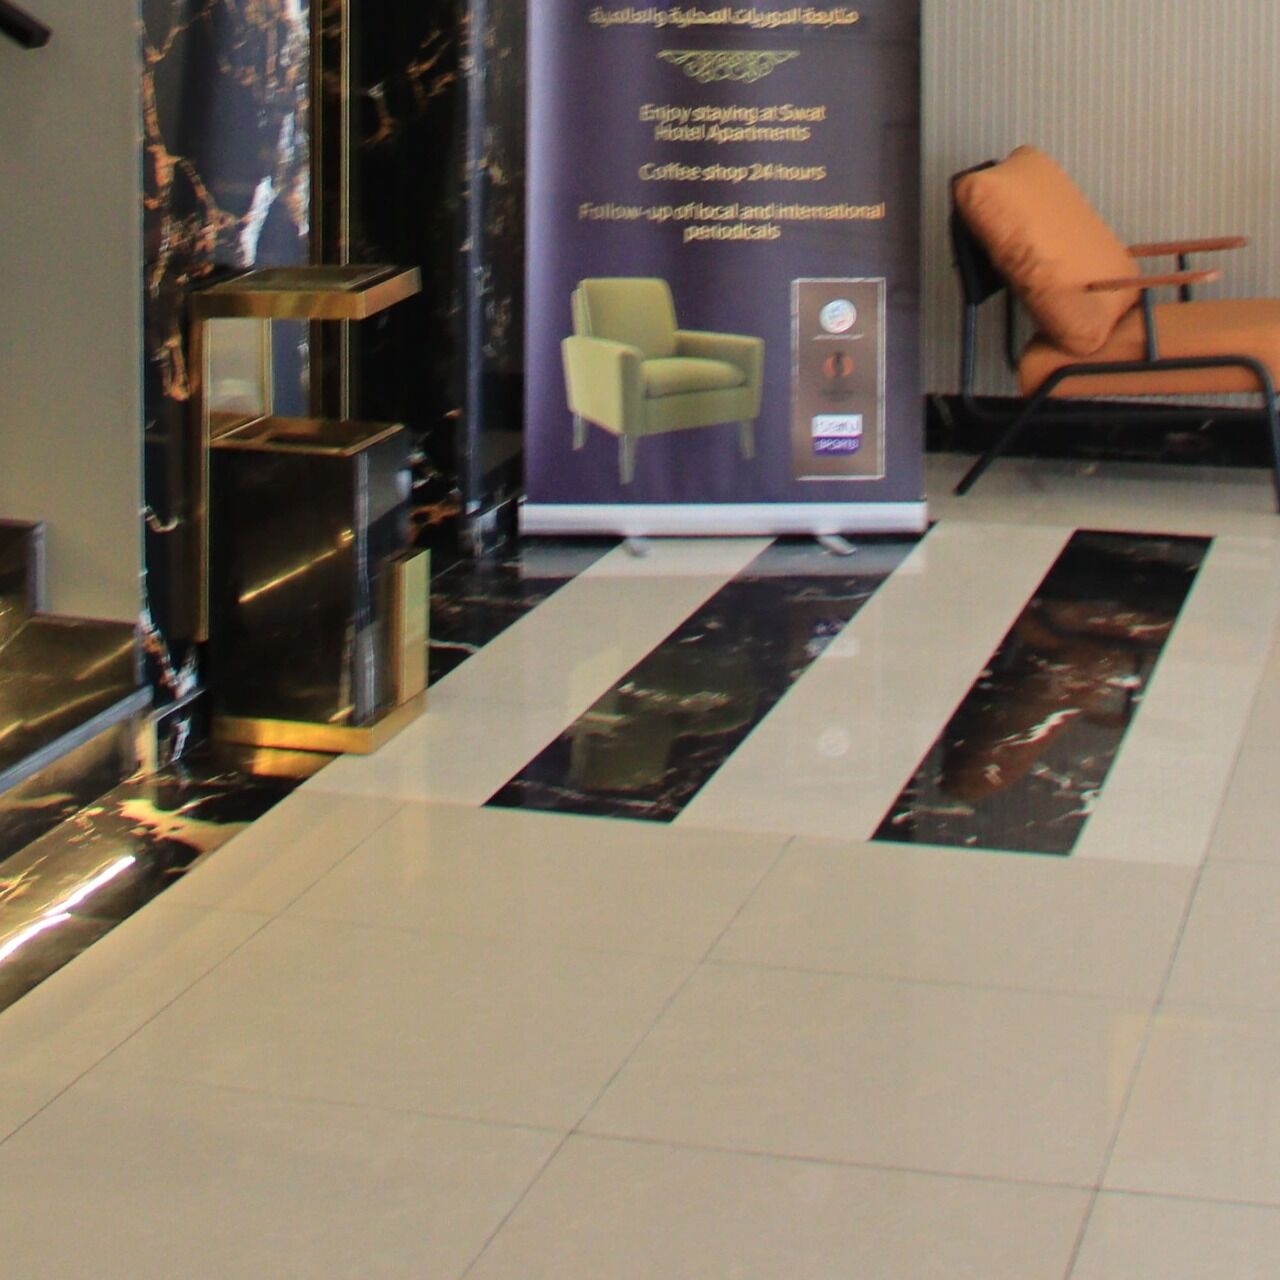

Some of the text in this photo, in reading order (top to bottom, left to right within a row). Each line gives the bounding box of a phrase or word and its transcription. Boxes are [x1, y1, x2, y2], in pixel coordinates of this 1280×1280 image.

[639, 103, 827, 126] Enjoy staying at Swat
[654, 124, 812, 145] Hotel Apartments
[639, 162, 827, 184] Coffee shop 24 hours
[578, 201, 886, 223] Follow-up of local and international
[683, 222, 782, 244] periodicals
